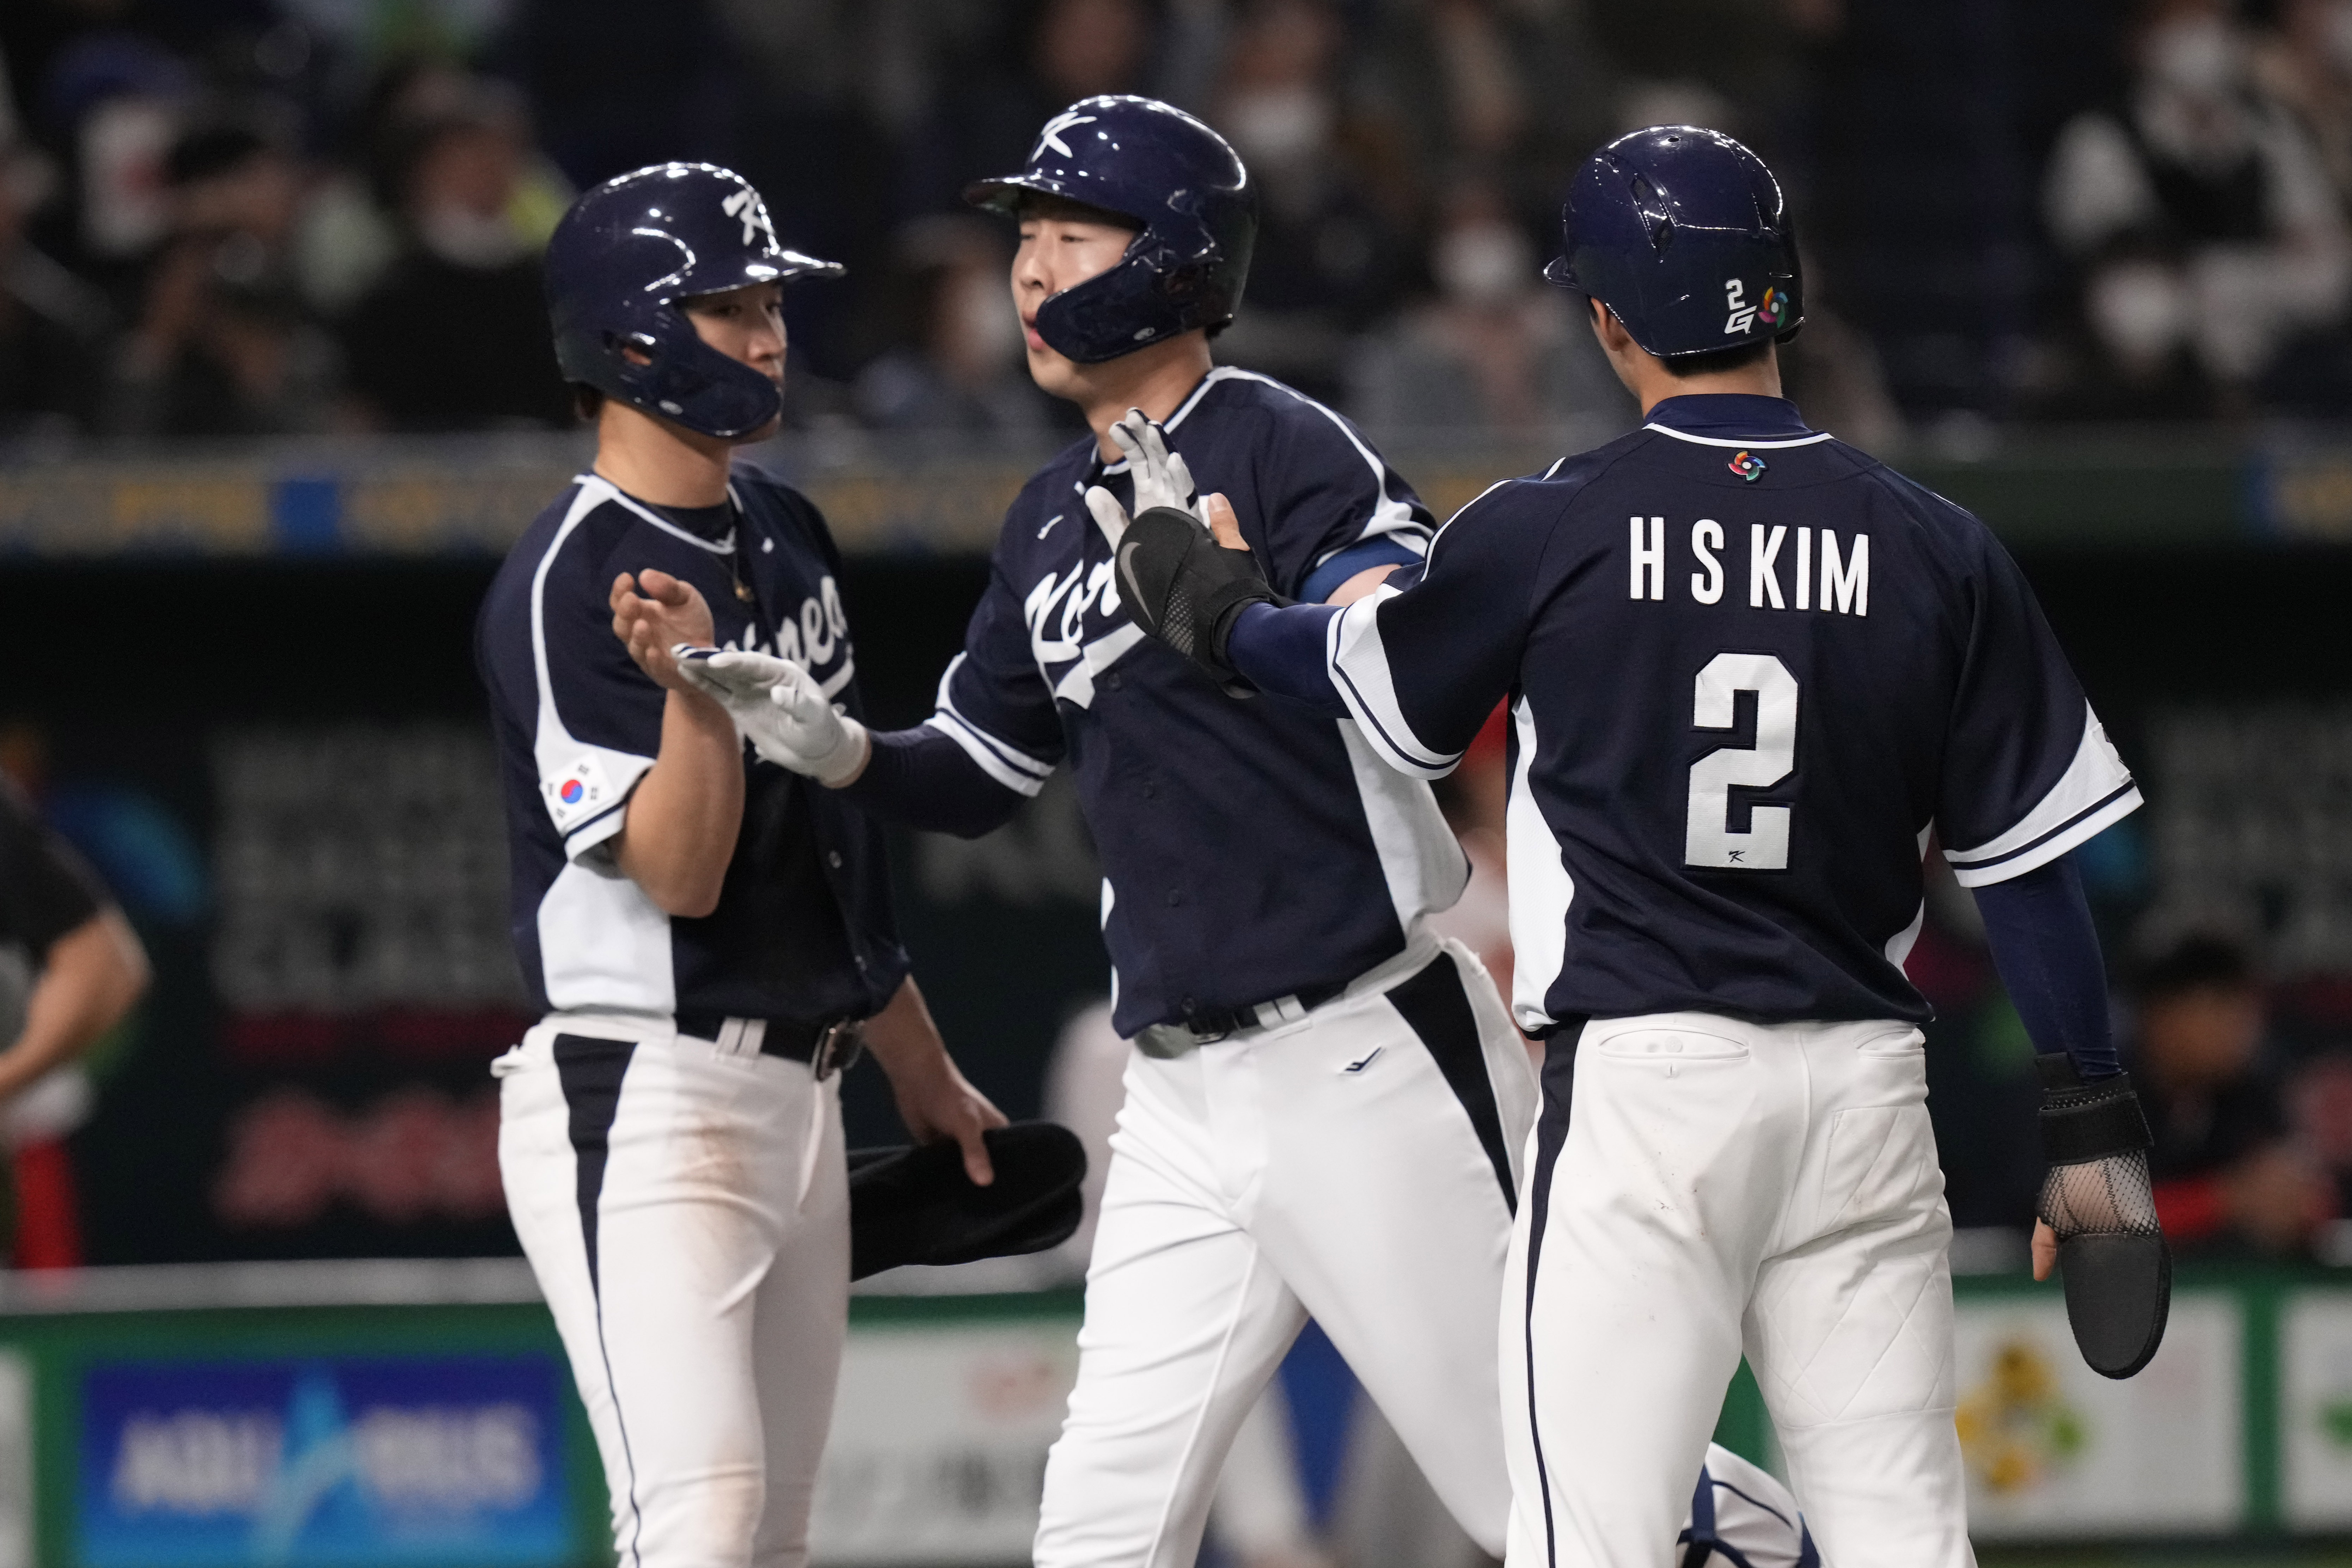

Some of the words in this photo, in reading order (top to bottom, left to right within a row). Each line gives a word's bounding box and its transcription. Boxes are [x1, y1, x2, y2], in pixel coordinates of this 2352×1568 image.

[1725, 278, 1746, 311] 2
[1629, 516, 1665, 601] H
[1691, 518, 1725, 605] S
[1750, 523, 1870, 618] KIM
[1685, 653, 1799, 870] 2
